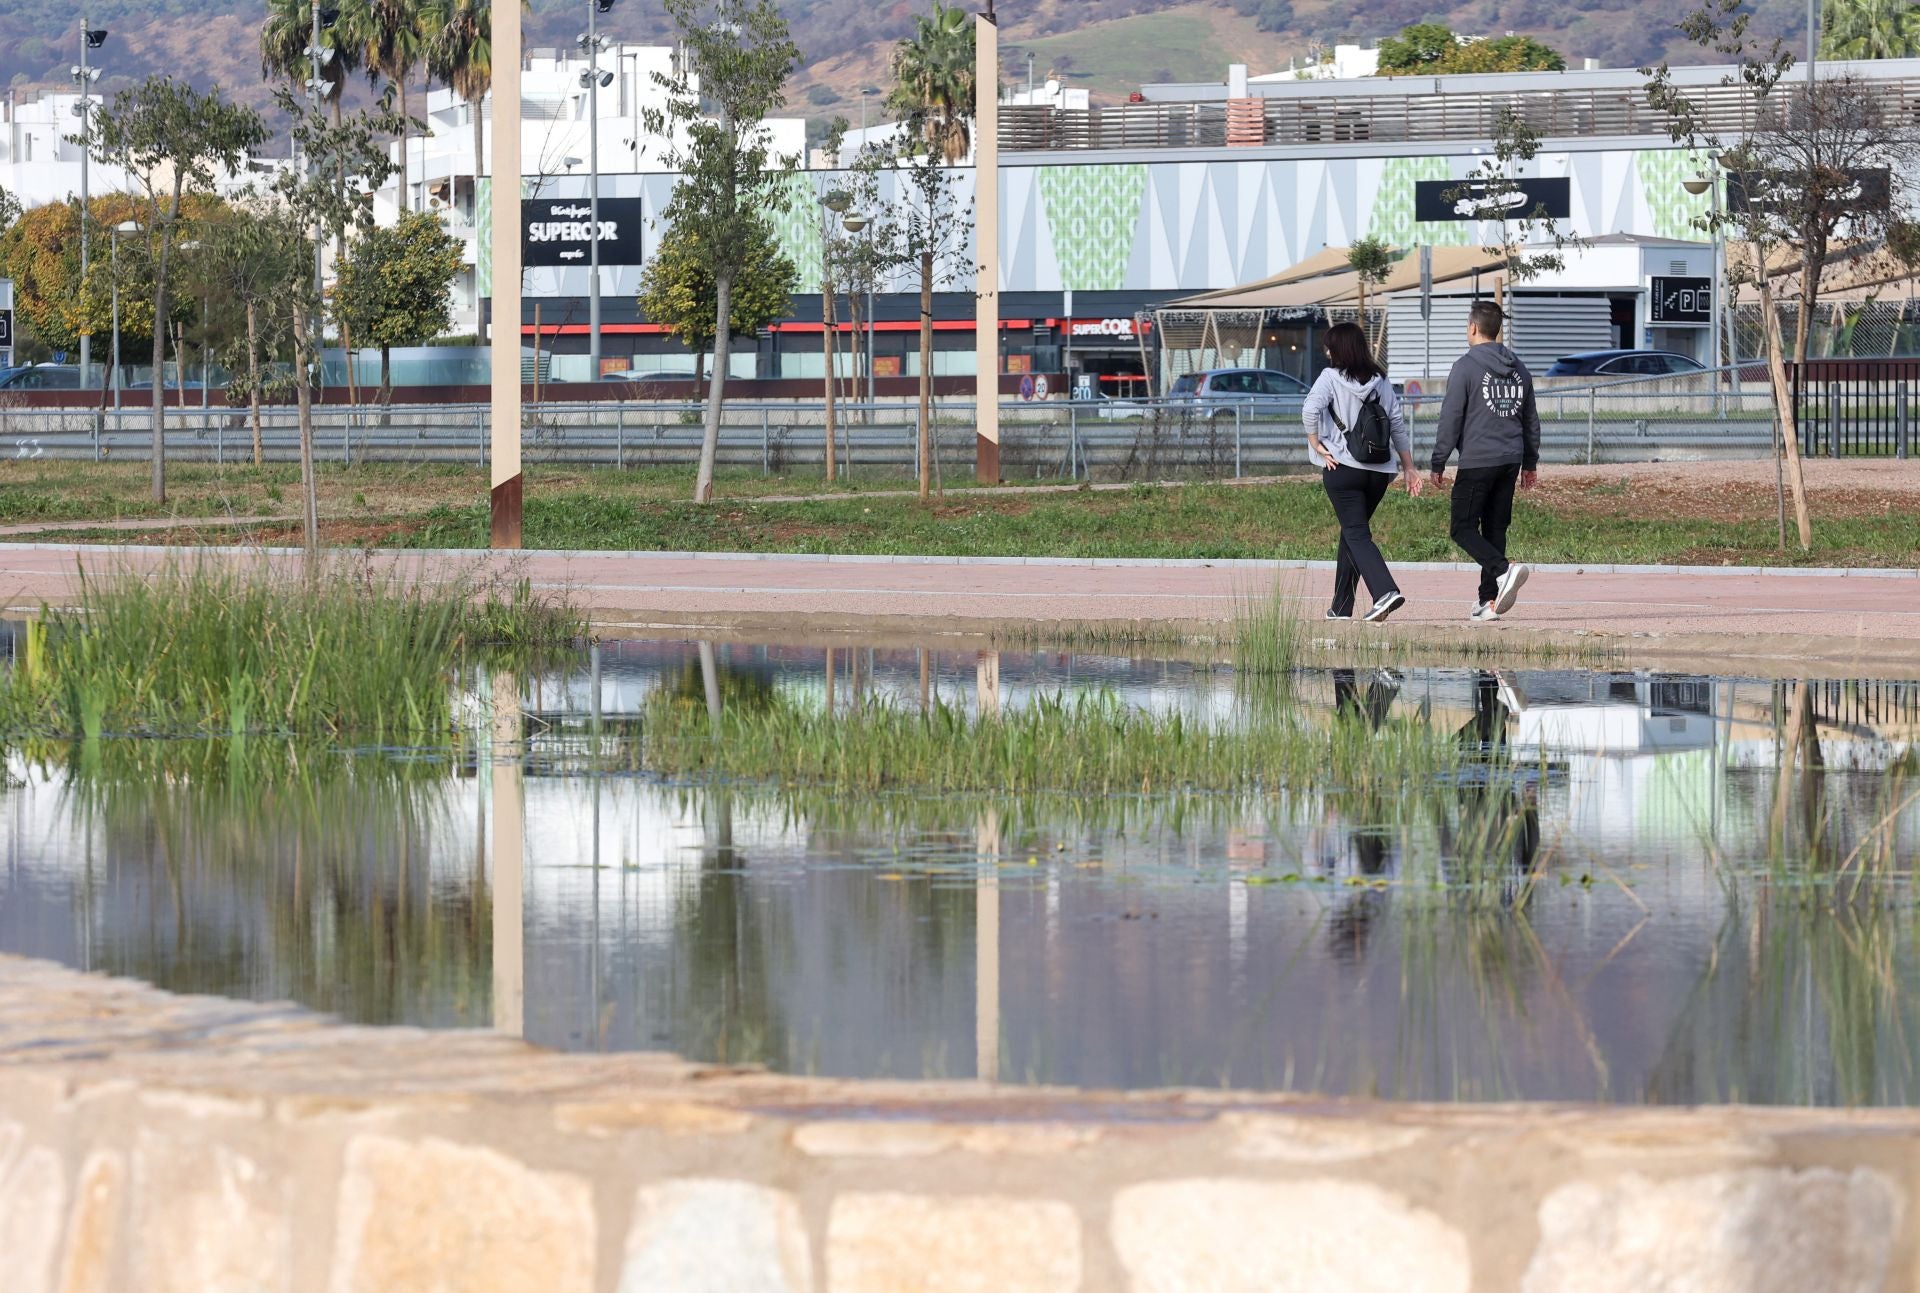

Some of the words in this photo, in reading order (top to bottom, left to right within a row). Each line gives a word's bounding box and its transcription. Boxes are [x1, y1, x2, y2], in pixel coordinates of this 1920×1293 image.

[528, 221, 619, 242] SUPERCOR
[1684, 294, 1690, 308] P
[1072, 319, 1131, 335] SUPERCOR
[1037, 383, 1045, 393] 20
